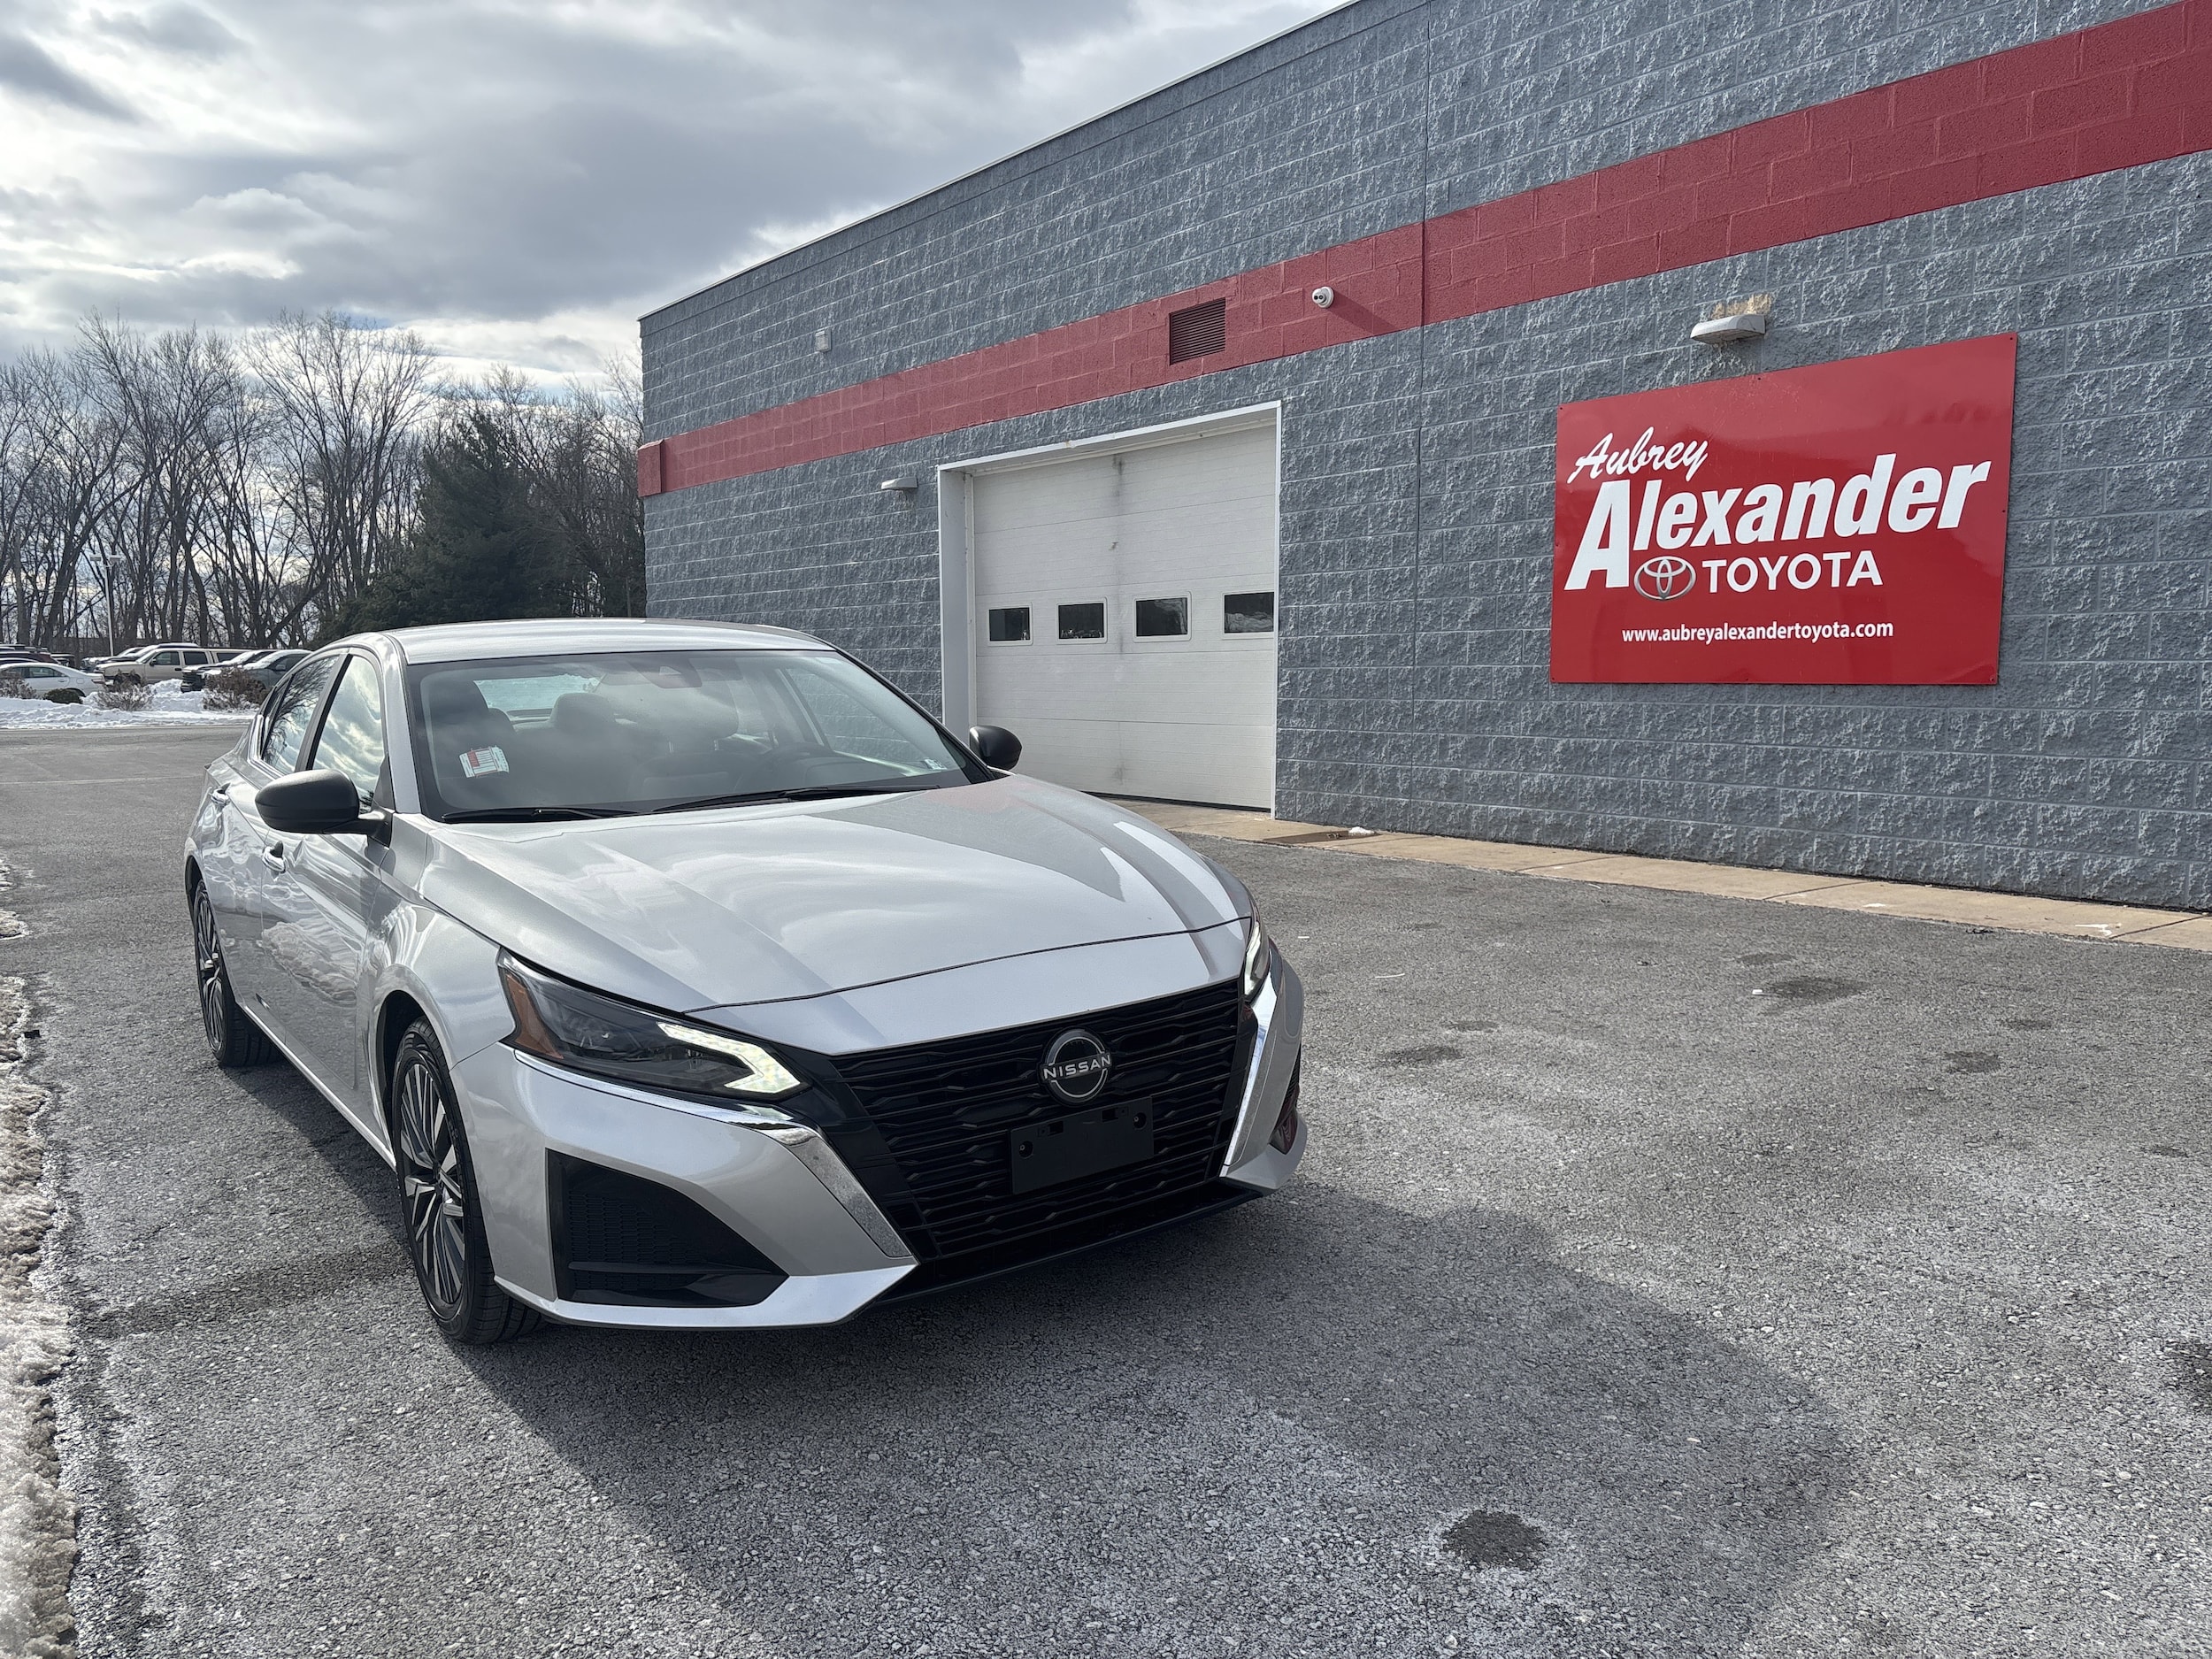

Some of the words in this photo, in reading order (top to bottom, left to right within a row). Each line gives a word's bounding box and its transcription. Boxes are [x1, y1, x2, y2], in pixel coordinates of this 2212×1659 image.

[1567, 427, 1708, 482] Aubrey
[1564, 454, 1992, 590] Alexander
[1702, 550, 1883, 593] TOYOTA
[1622, 621, 1893, 645] www.aubreyalexandertoyota.com
[1043, 1054, 1111, 1079] NISSAN
